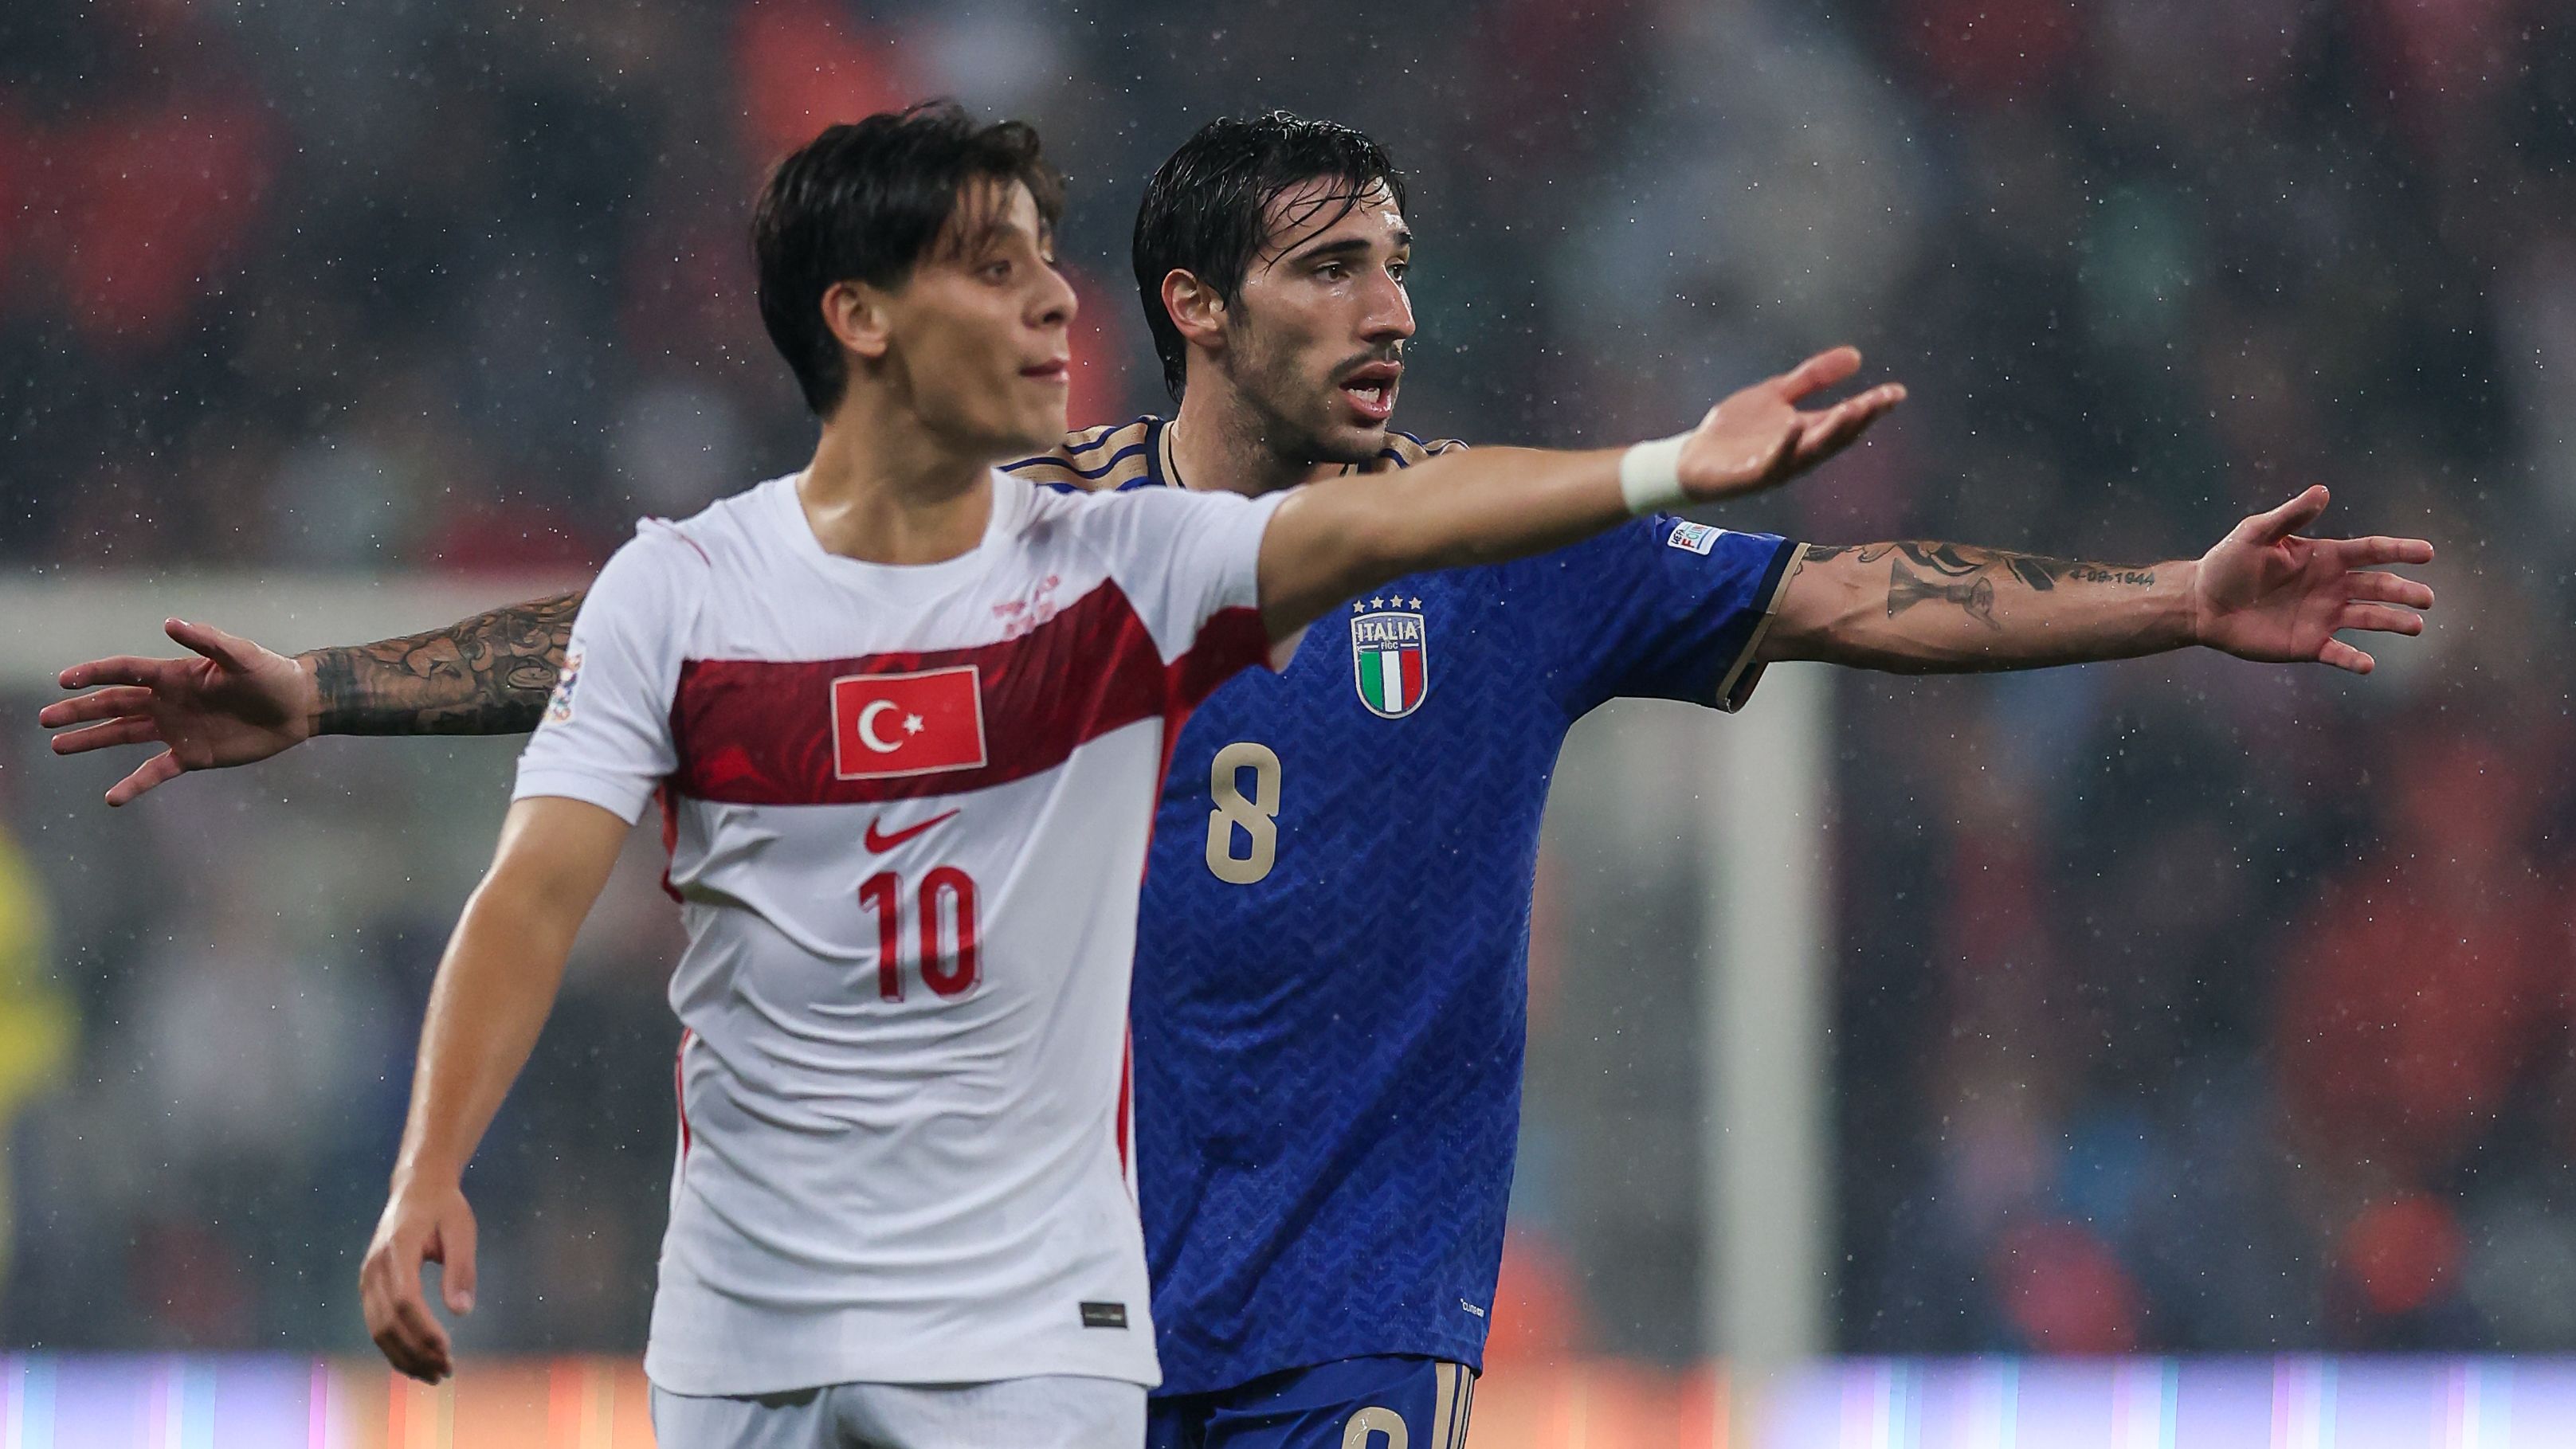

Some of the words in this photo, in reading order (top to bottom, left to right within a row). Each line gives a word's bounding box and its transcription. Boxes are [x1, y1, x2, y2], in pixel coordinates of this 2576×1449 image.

[1671, 529, 1685, 545] UEFA
[1358, 621, 1418, 642] ITALIA
[1206, 742, 1281, 884] 8
[858, 866, 982, 1002] 10
